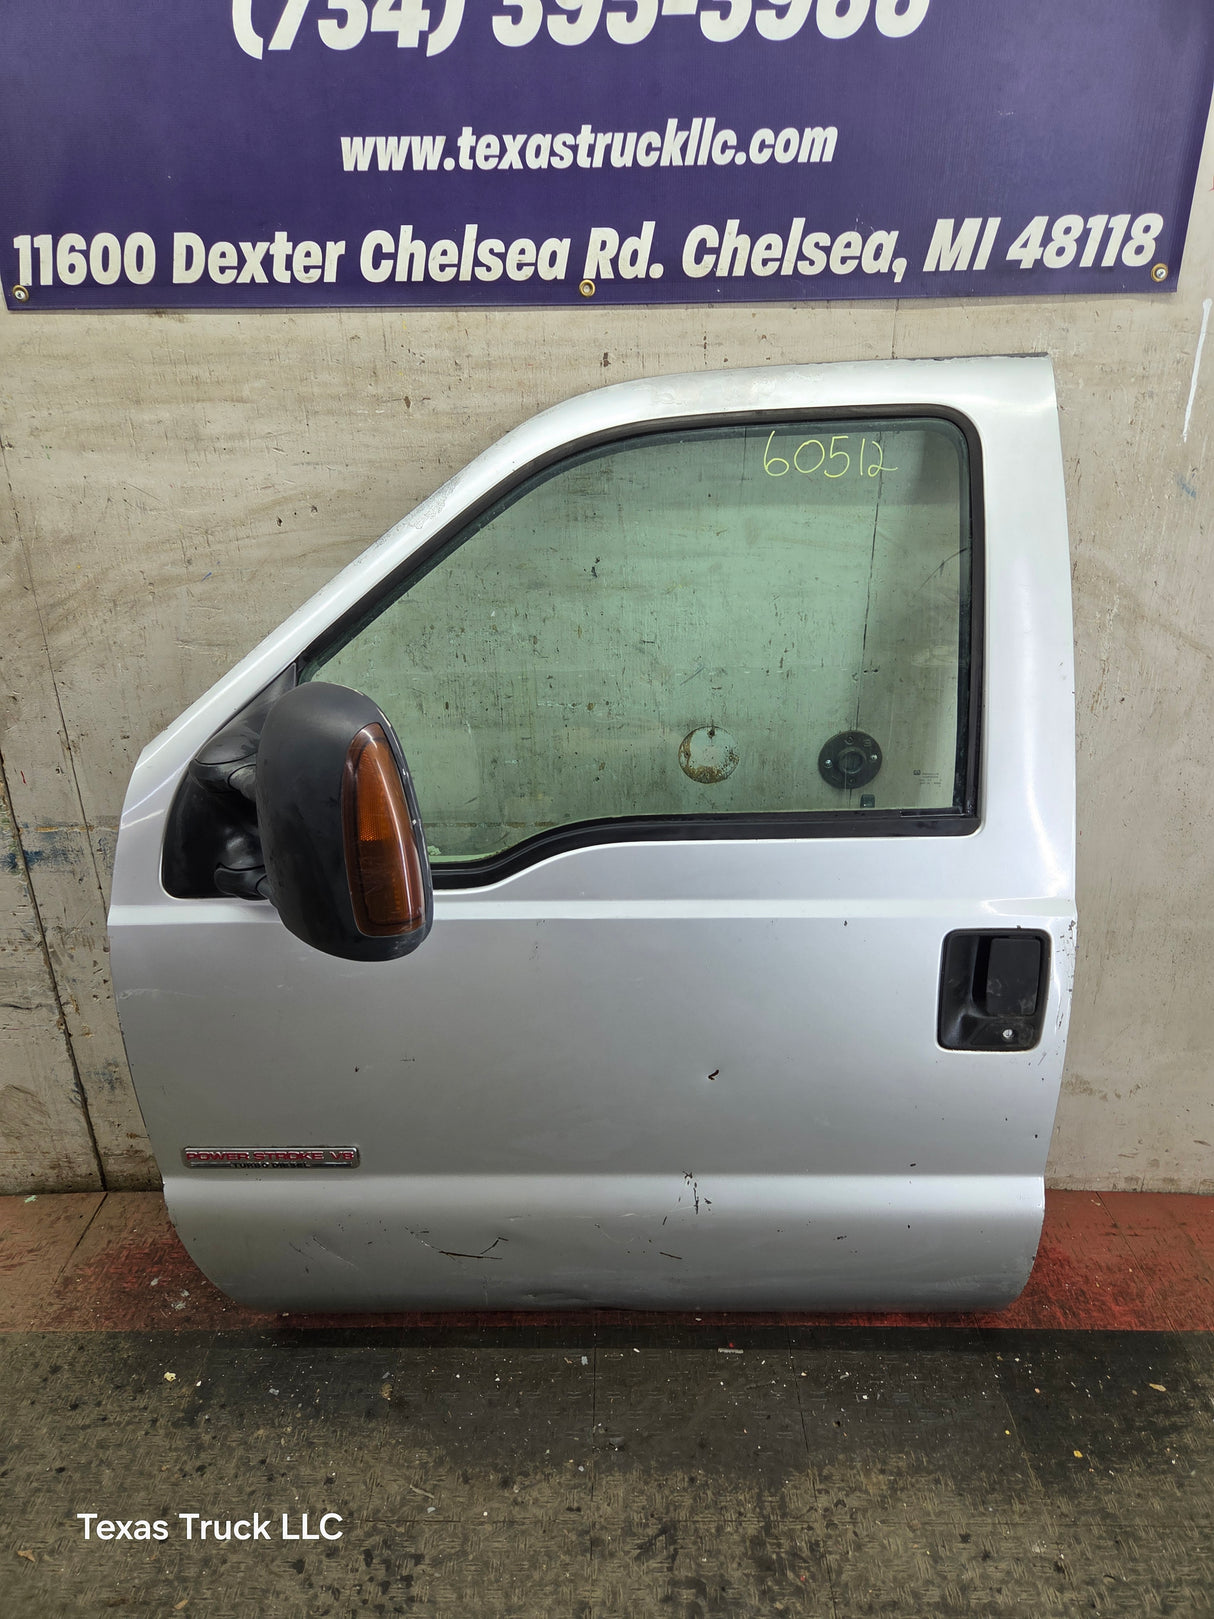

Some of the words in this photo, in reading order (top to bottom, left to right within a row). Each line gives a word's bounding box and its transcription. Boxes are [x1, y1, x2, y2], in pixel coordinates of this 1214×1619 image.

[340, 117, 839, 172] www.texastruckllc.com
[13, 231, 156, 287] 11600
[172, 231, 346, 285] Dexter
[359, 223, 572, 283] Chelsea
[582, 220, 664, 281] Rd.
[682, 217, 908, 283] Chelsea,
[922, 216, 1002, 272] MI
[1005, 212, 1165, 270] 48118
[763, 430, 899, 479] 60512
[186, 1151, 250, 1161] POWER
[253, 1151, 325, 1161] STROKE
[329, 1151, 354, 1161] V8
